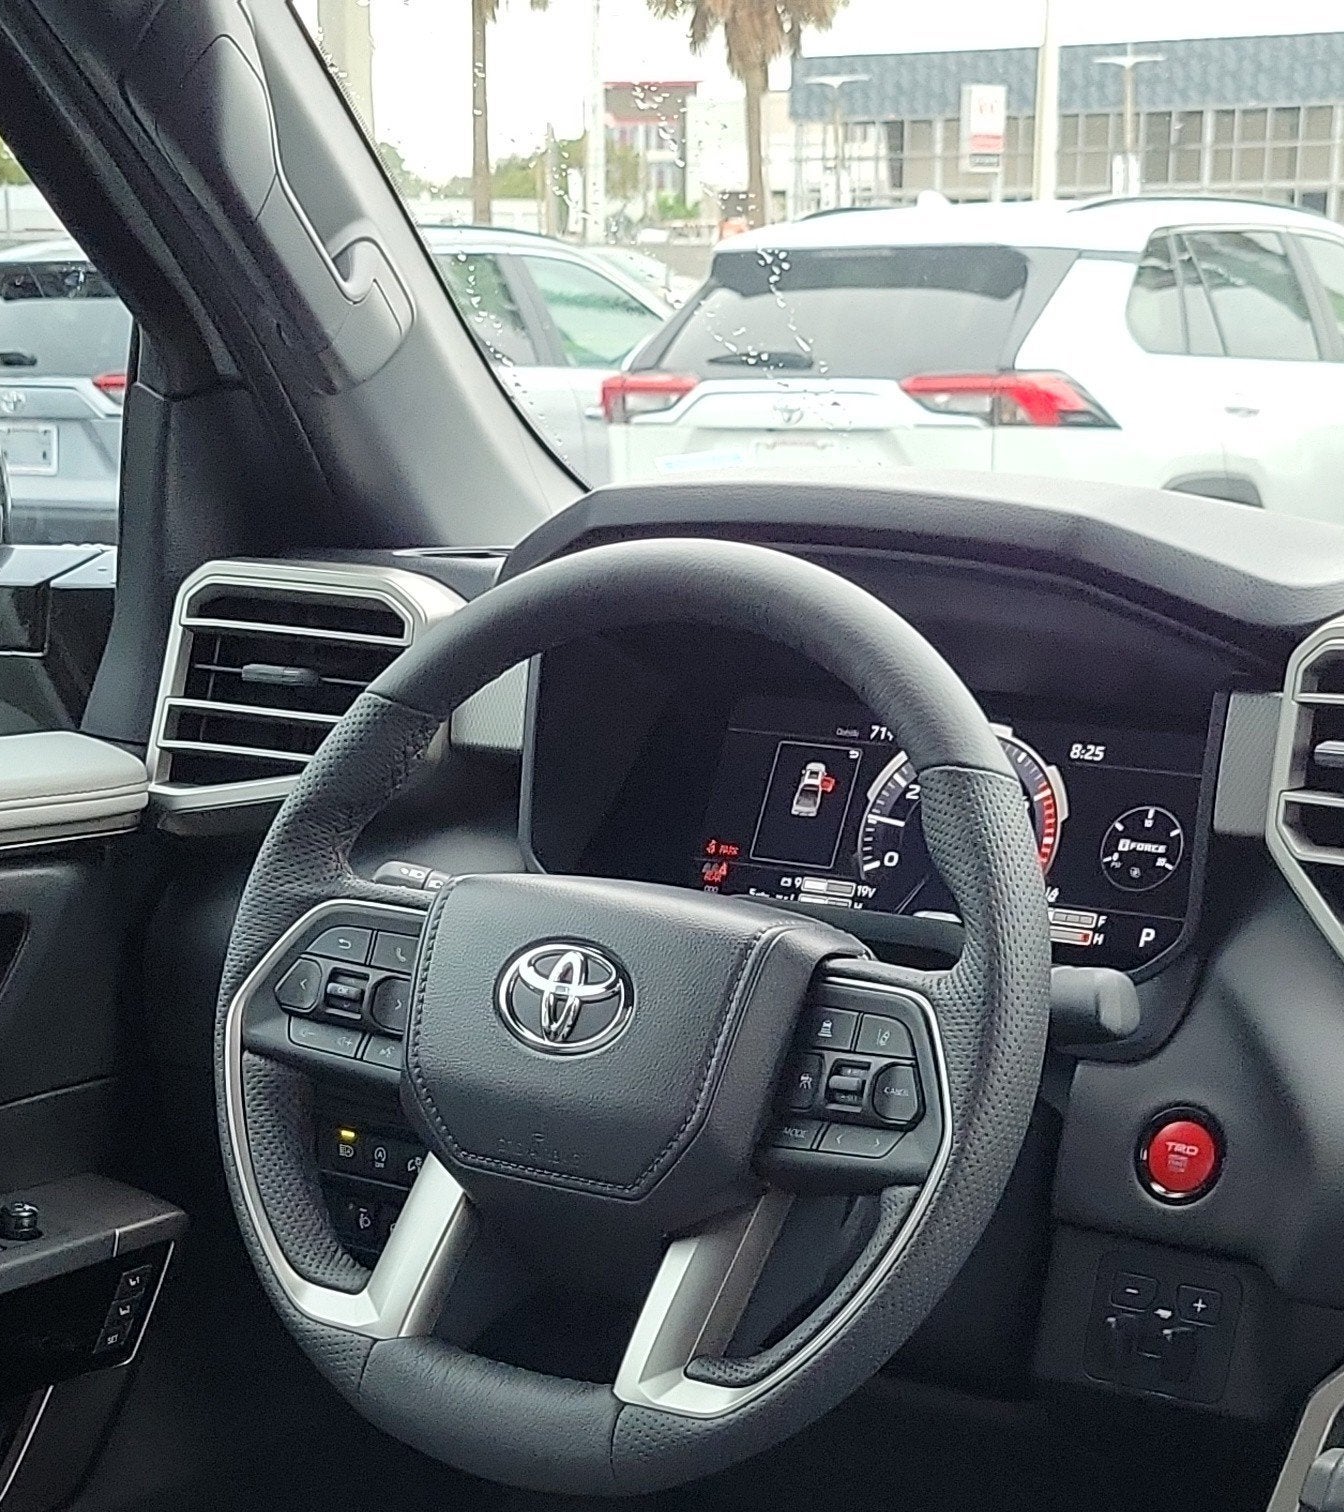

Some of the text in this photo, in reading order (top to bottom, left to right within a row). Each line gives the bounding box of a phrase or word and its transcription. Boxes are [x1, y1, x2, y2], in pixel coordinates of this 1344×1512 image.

[1069, 743, 1105, 761] 8:25
[905, 784, 921, 800] 2
[883, 852, 899, 867] 0
[794, 876, 802, 888] 9
[1098, 915, 1108, 928] F
[1093, 933, 1105, 946] H
[1138, 927, 1156, 948] P
[1165, 1141, 1199, 1156] TRD
